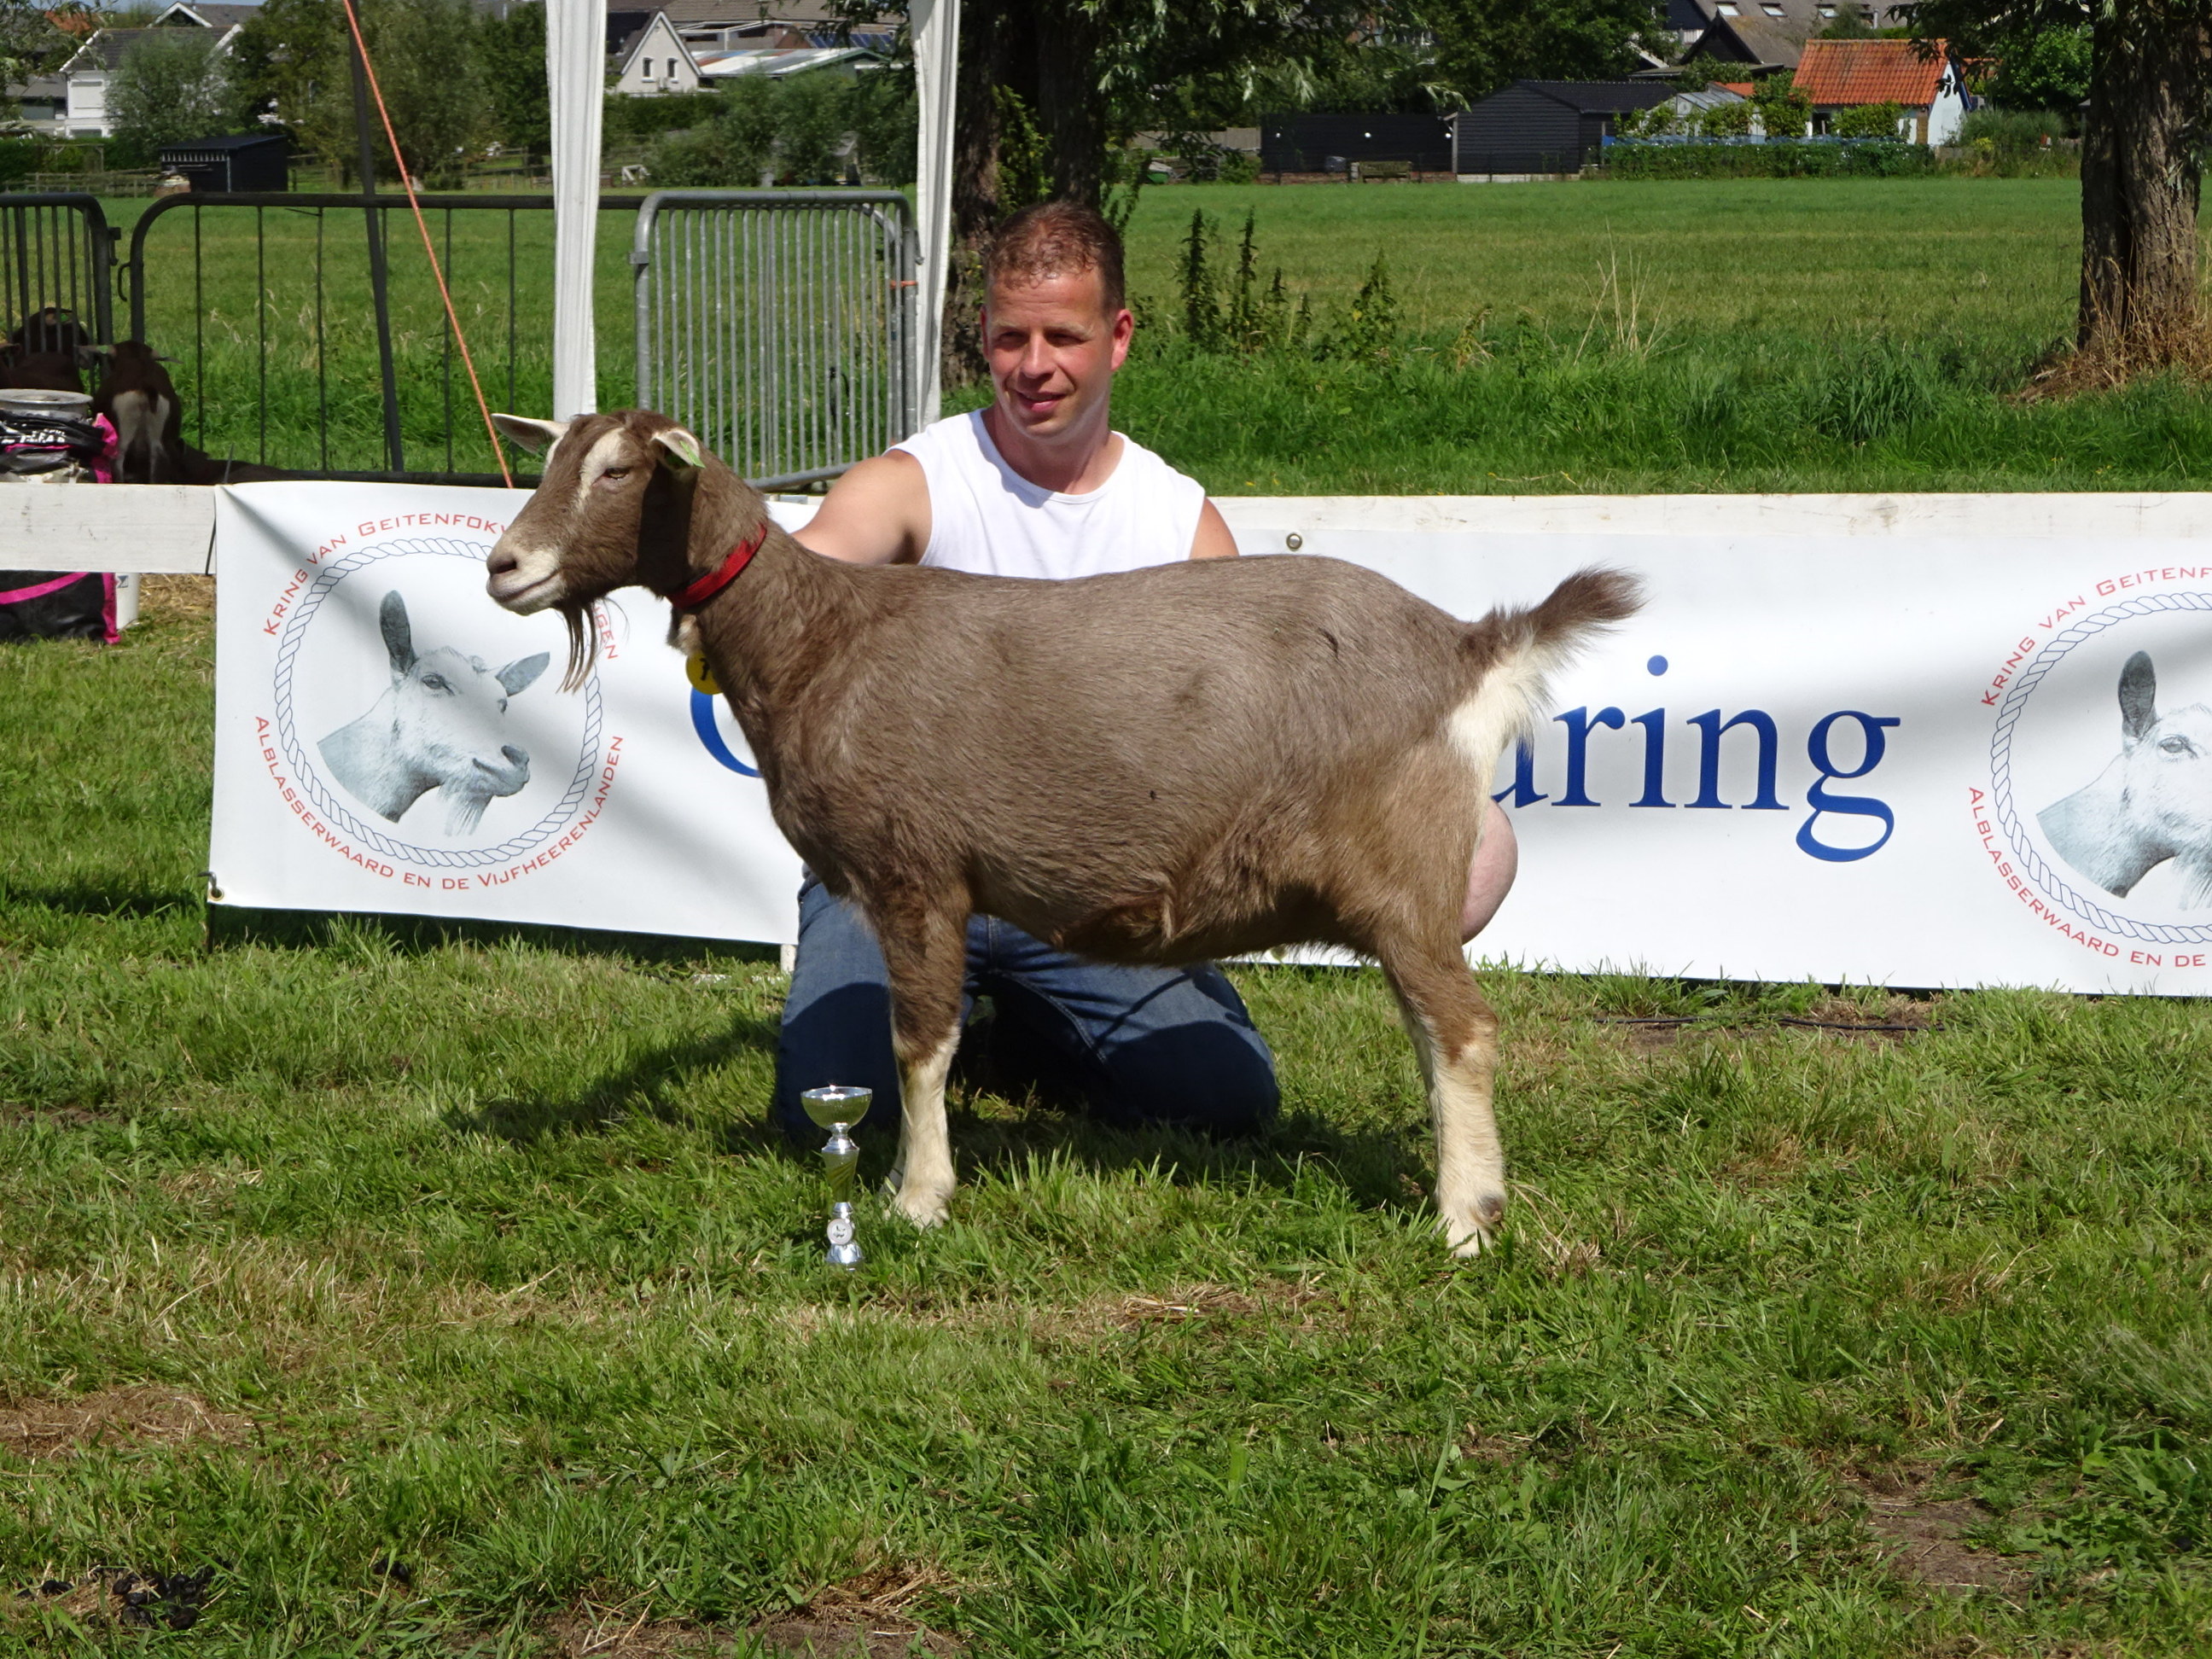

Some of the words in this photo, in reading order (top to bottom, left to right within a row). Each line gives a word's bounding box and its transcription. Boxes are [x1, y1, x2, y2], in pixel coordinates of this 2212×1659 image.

[263, 569, 308, 636] KRING
[306, 534, 346, 567] VAN
[1981, 637, 2035, 706] KRING
[2039, 596, 2087, 629] VAN
[255, 716, 394, 878] ALBLASSERWAARD
[403, 872, 432, 888] EN
[442, 877, 469, 890] DE
[478, 736, 624, 887] VIJFHEERENLANDEN
[1968, 787, 2119, 957] ALBLASSERWAARD
[2130, 951, 2162, 967] EN
[2174, 954, 2206, 967] DE
